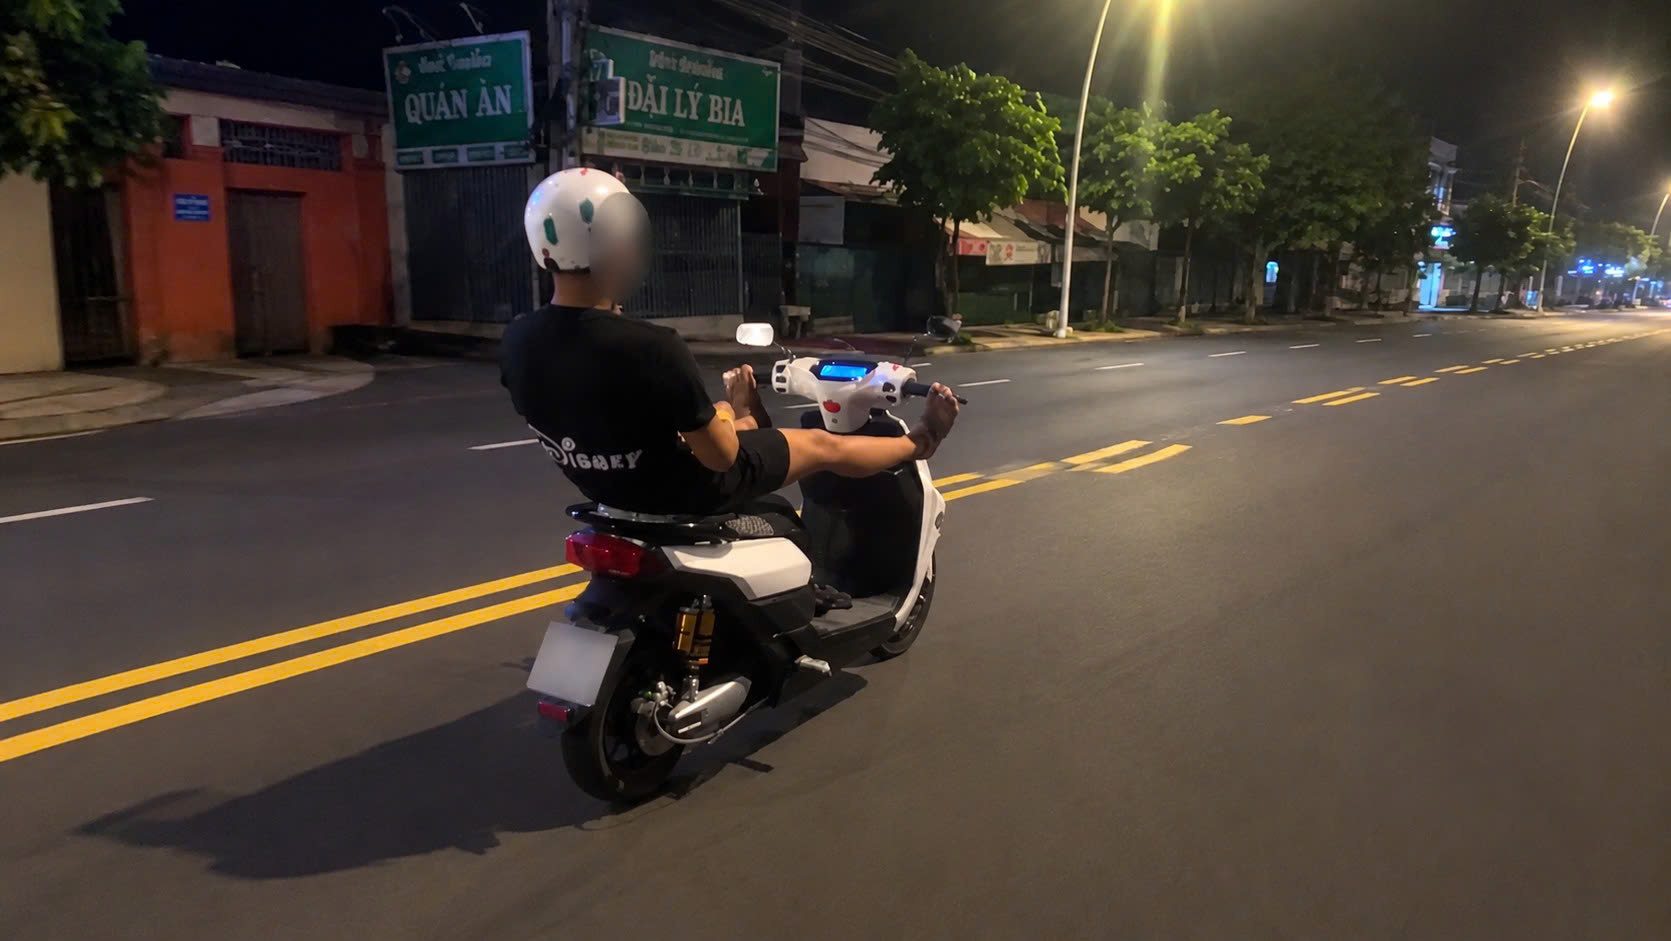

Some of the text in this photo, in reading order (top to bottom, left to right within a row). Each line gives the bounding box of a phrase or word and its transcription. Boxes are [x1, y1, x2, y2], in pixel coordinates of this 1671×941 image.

[404, 82, 468, 125] QUÁN
[673, 82, 703, 121] LÝ
[707, 94, 746, 127] BIA
